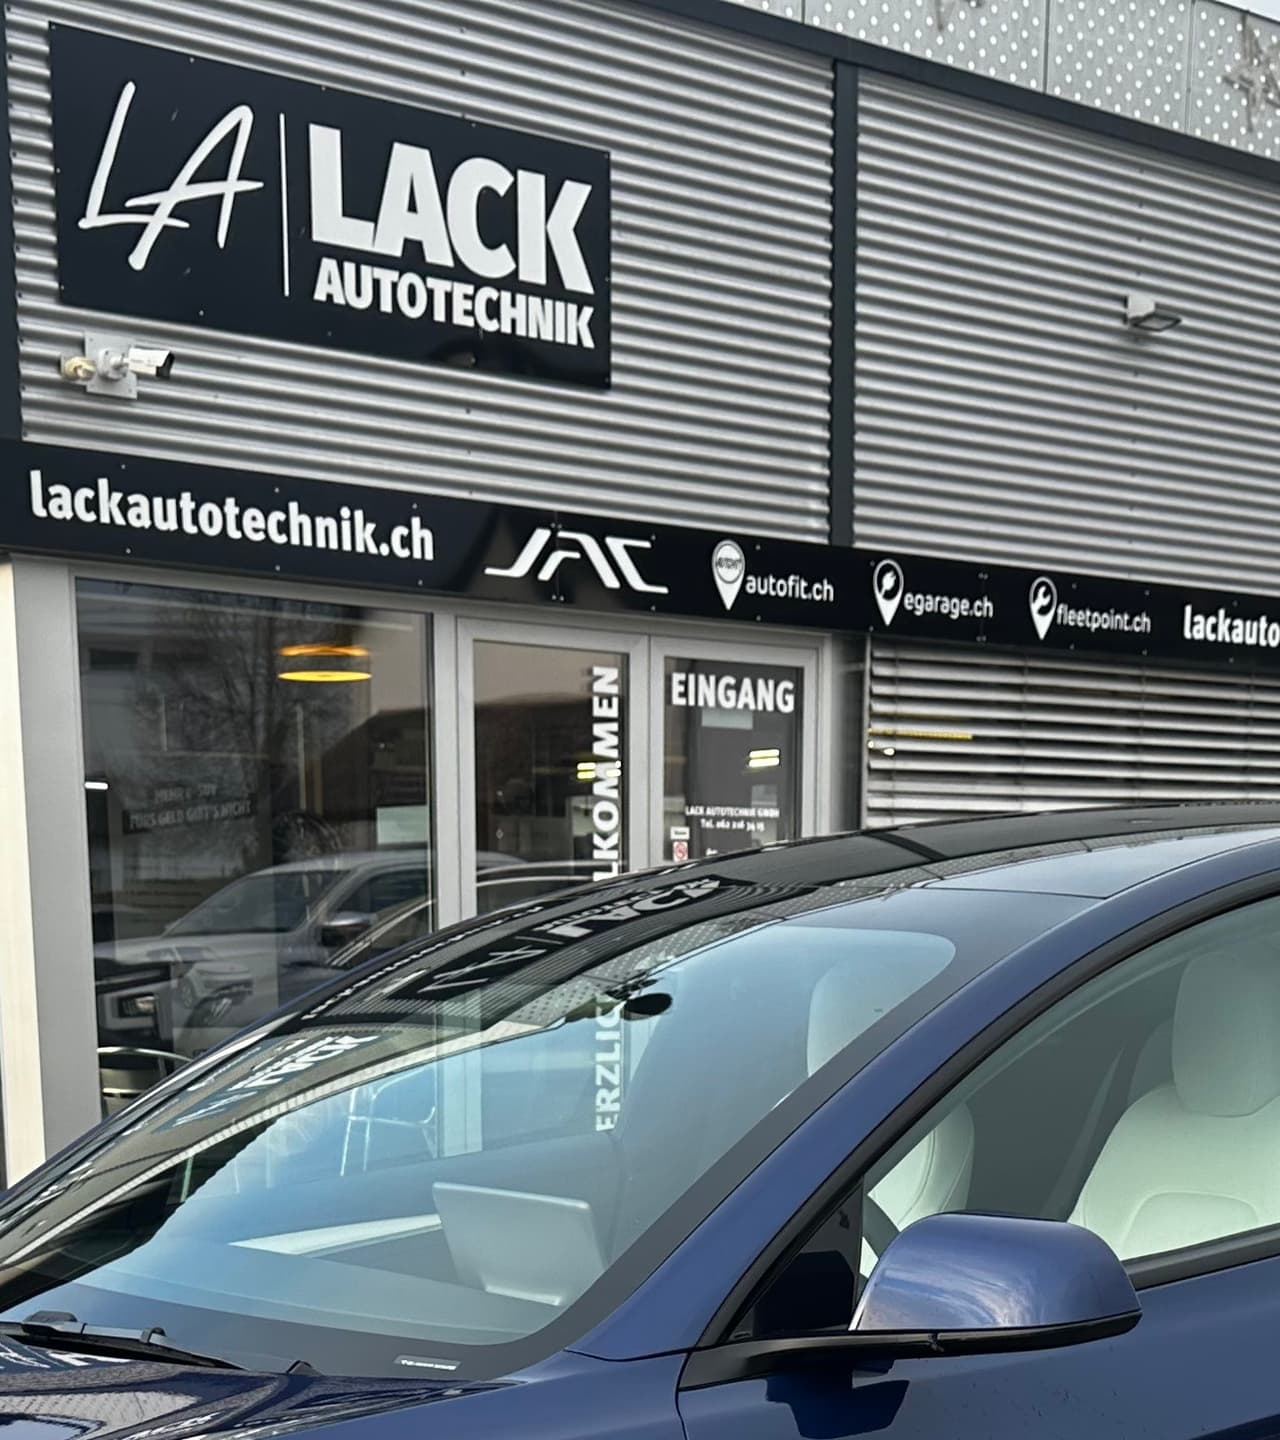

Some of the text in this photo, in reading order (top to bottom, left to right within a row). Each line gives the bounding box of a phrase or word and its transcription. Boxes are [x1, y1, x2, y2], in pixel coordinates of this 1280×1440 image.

[79, 81, 264, 271] LA
[308, 123, 595, 296] LACK
[313, 257, 595, 349] AUTOTECHNIK
[29, 469, 436, 562] lackautotechnik.ch
[745, 573, 835, 602] autofit.ch
[903, 589, 994, 620] egarage.ch
[1056, 603, 1151, 634] fleetpoint.ch
[671, 672, 795, 714] EINGANG
